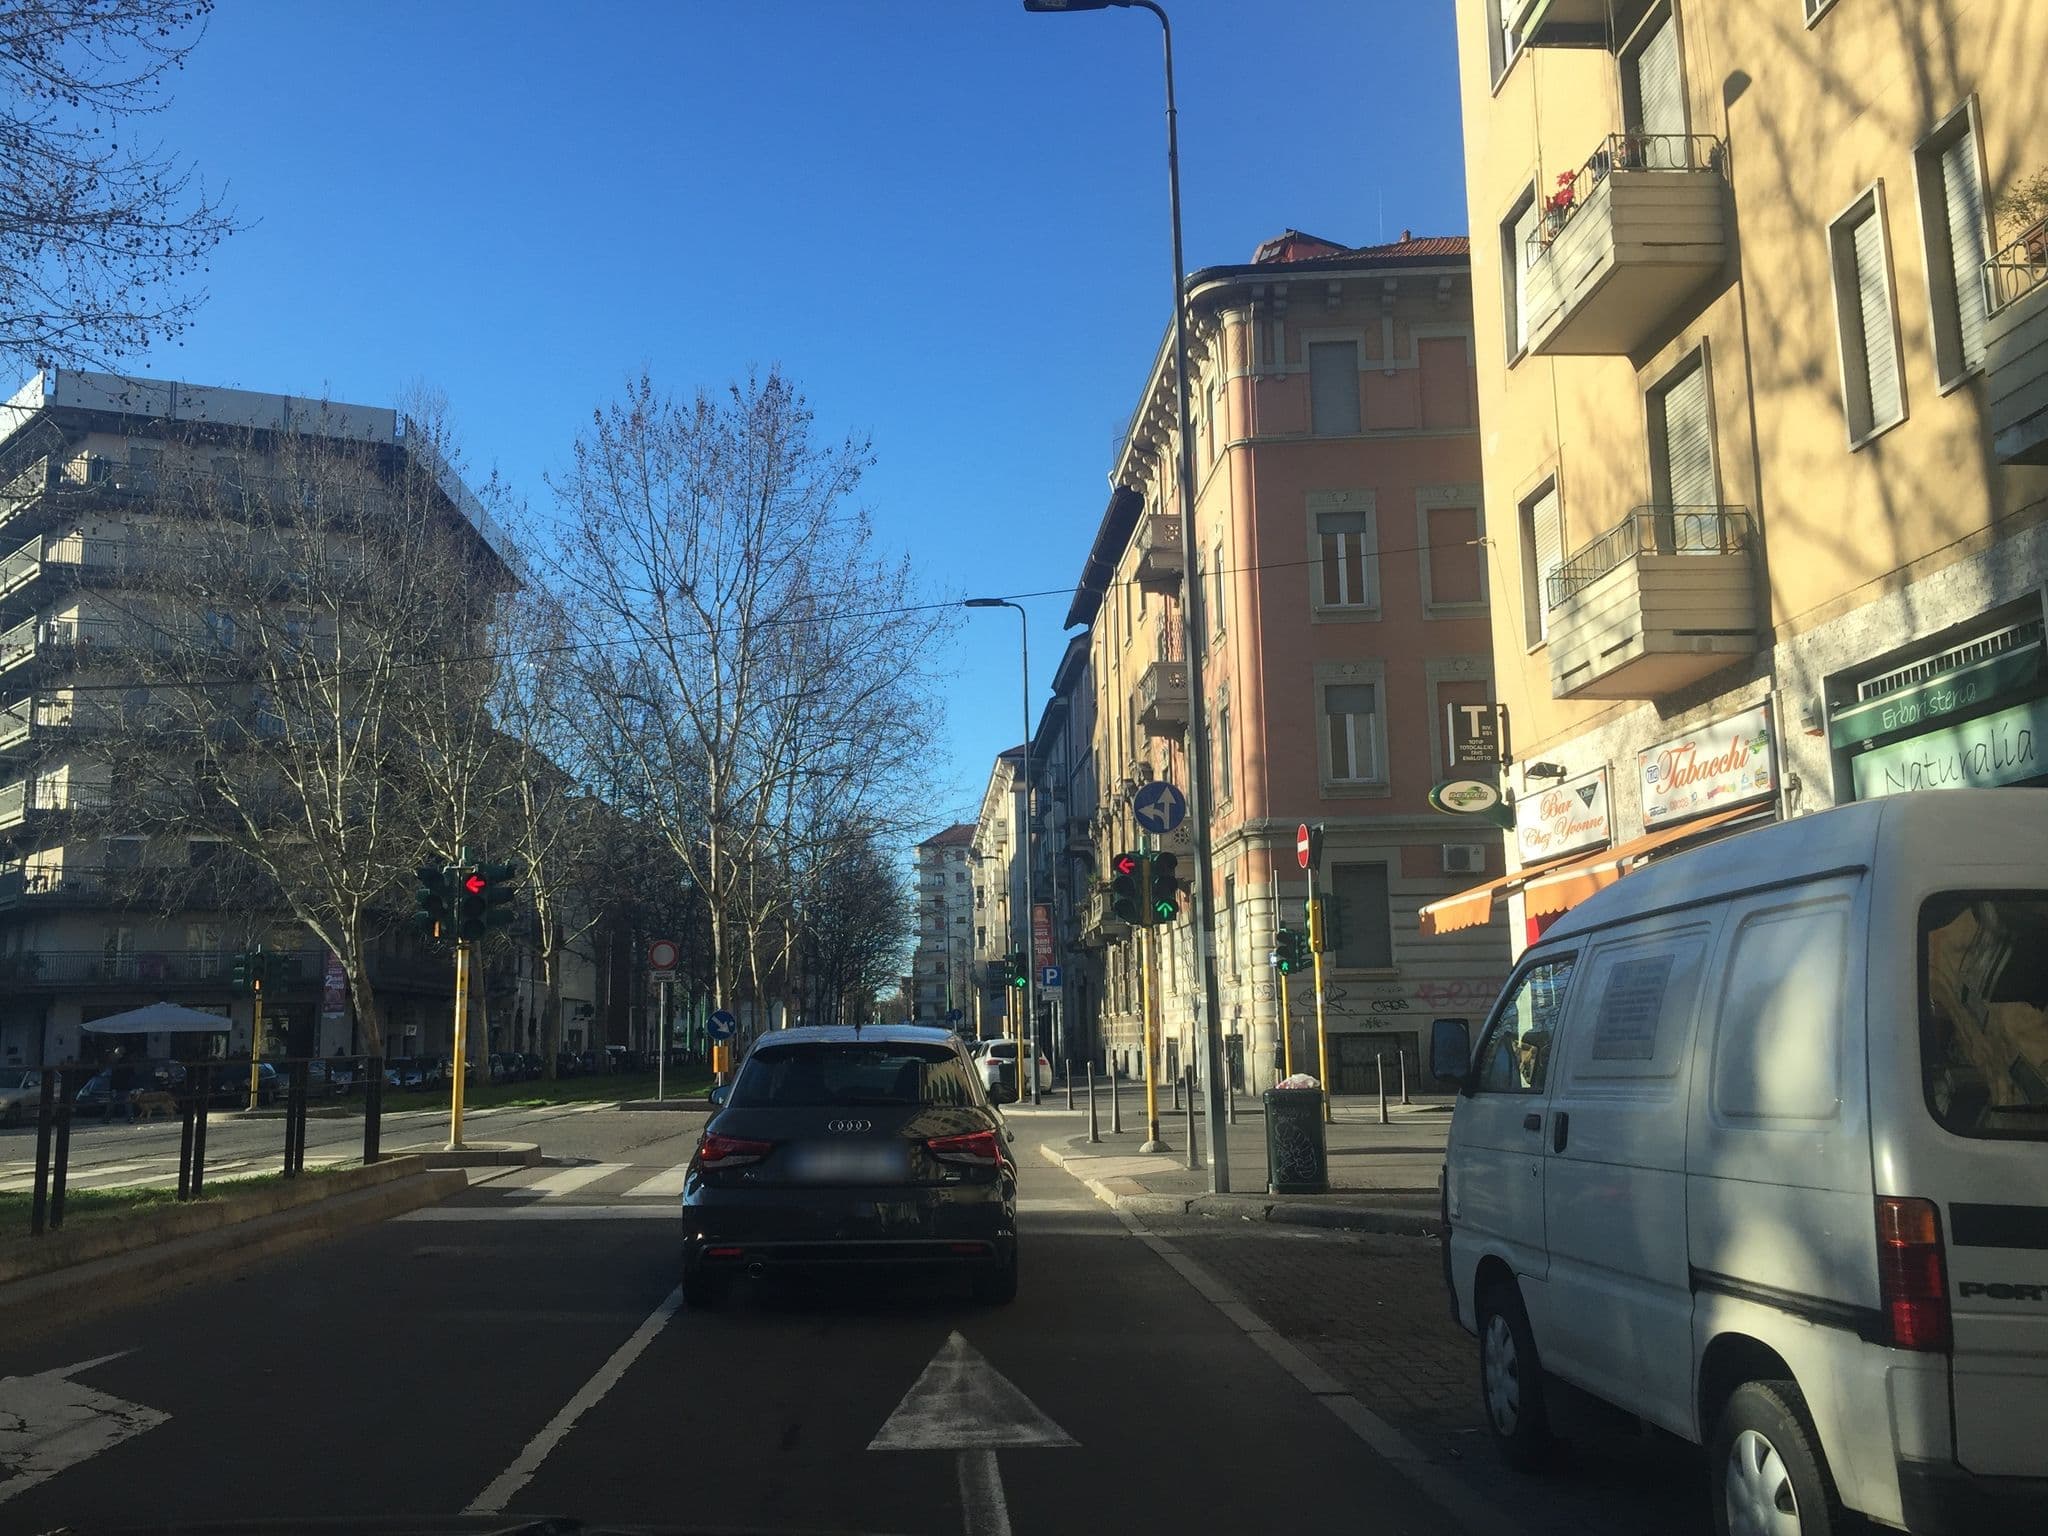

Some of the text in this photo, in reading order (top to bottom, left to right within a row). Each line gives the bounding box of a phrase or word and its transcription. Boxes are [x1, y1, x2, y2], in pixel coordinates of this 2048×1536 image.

[1460, 705, 1488, 738] T
[1882, 682, 1976, 730] Erboristeria
[1656, 735, 1750, 795] Tabacchi
[1885, 722, 2034, 796] Naturalia
[1540, 790, 1573, 821] Bar
[1523, 816, 1604, 851] Chez Yvonne
[1046, 968, 1058, 984] P
